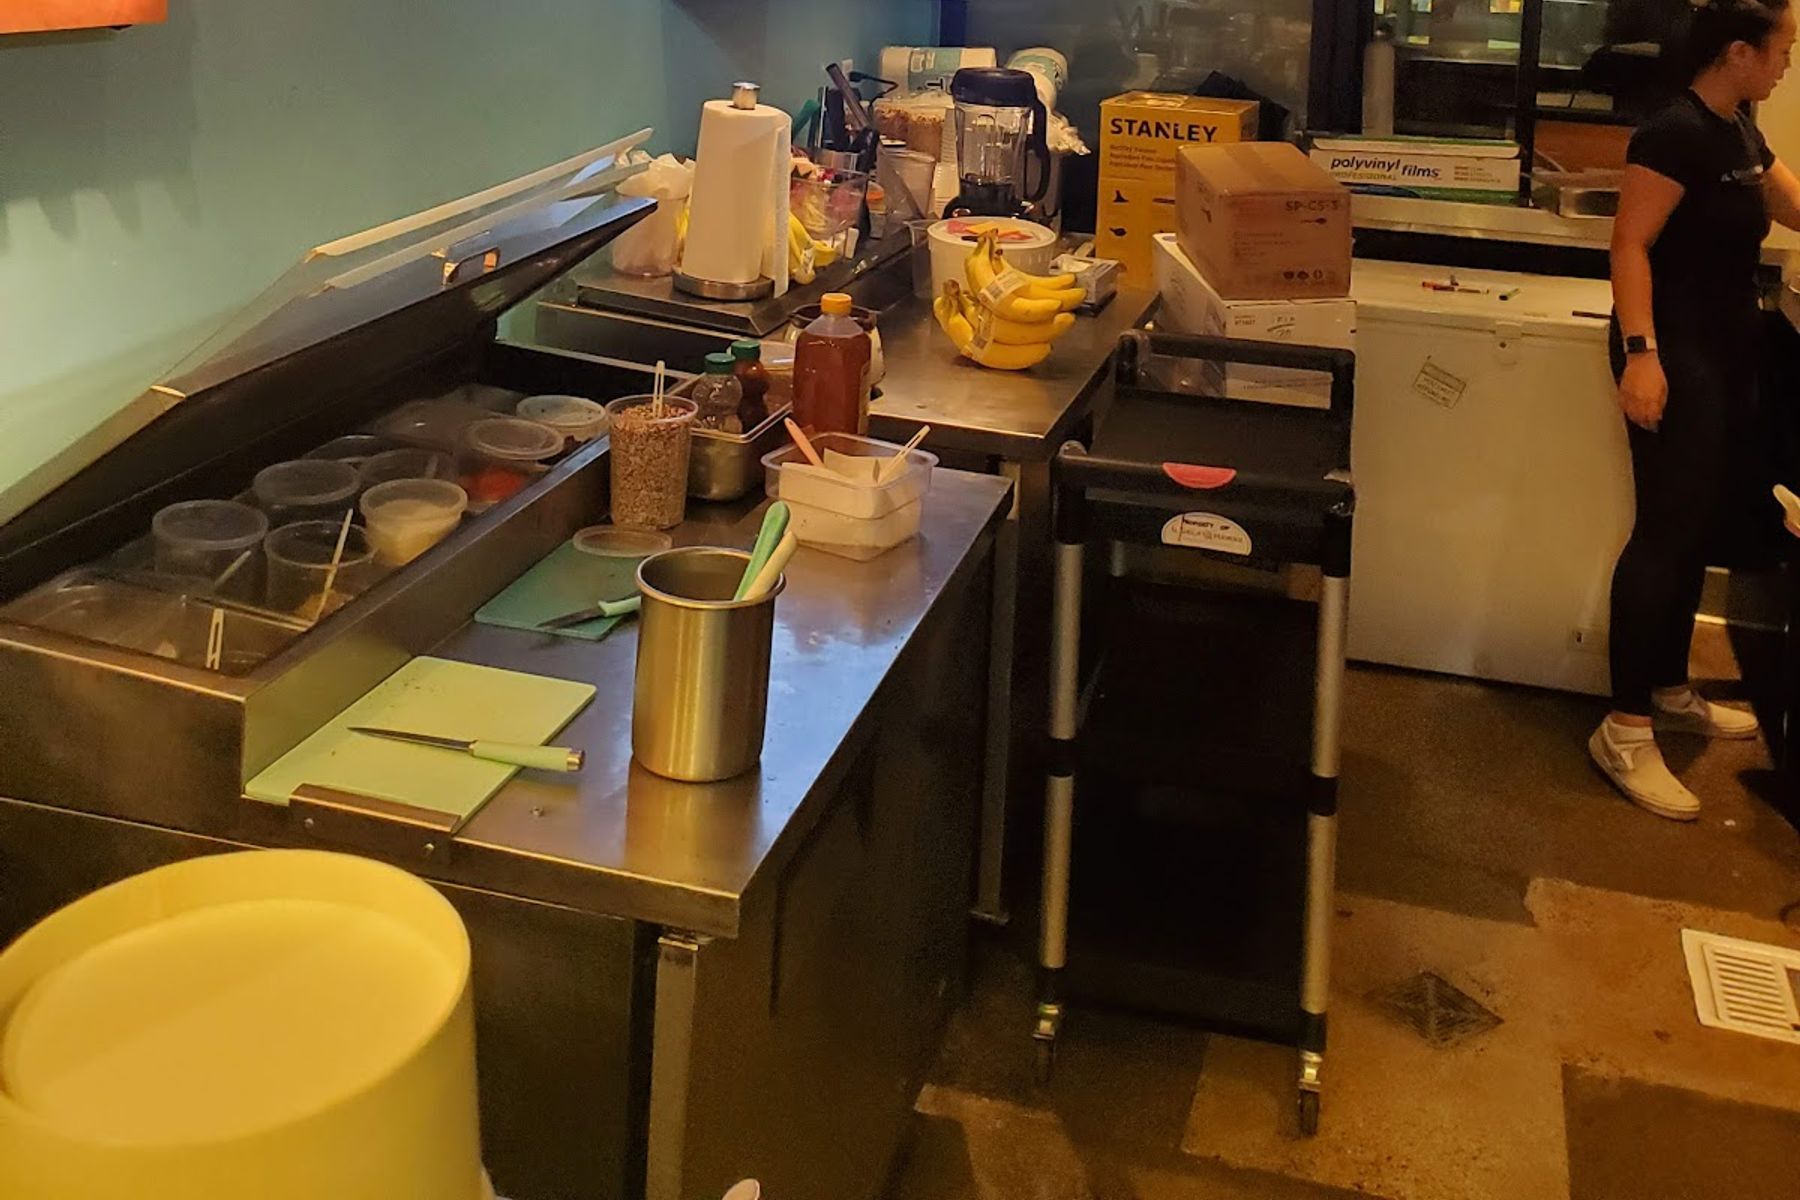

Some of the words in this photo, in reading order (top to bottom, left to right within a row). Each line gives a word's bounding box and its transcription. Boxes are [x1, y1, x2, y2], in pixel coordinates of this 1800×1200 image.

[1110, 118, 1217, 143] STANLEY
[1331, 156, 1400, 172] polyvinyl
[1401, 164, 1440, 178] films
